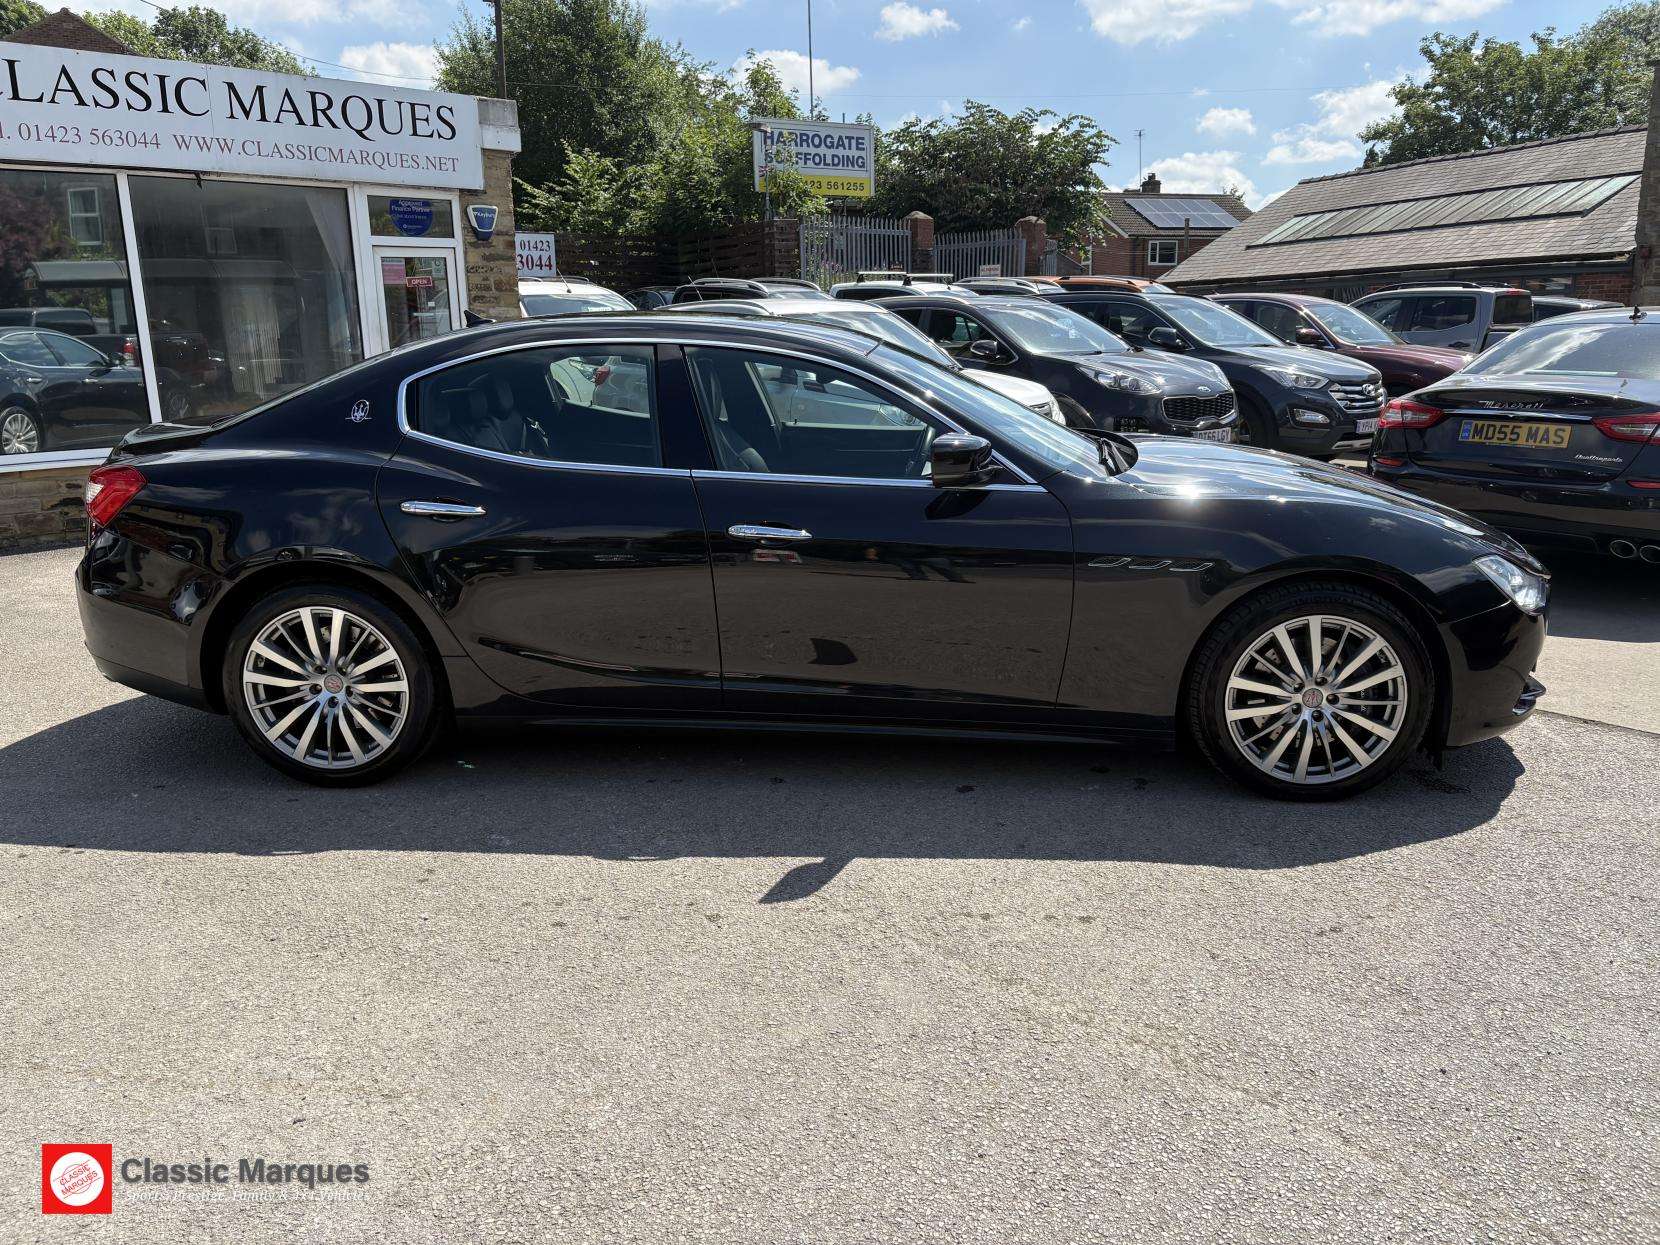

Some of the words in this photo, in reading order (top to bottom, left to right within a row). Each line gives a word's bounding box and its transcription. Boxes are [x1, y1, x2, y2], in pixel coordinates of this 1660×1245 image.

[0, 58, 210, 117] LASSIC
[222, 80, 457, 142] MARQUES
[18, 122, 82, 144] 01423
[89, 128, 161, 149] 563044
[172, 134, 459, 172] WWW.CLASSICMARQUES.NET
[763, 130, 866, 151] HARROGATE
[765, 151, 866, 169] SFFOLDING
[826, 180, 865, 192] 561255
[519, 239, 551, 252] 01423
[1478, 400, 1545, 409] Maserati
[1471, 423, 1523, 443] MD55
[1524, 426, 1567, 446] MAS
